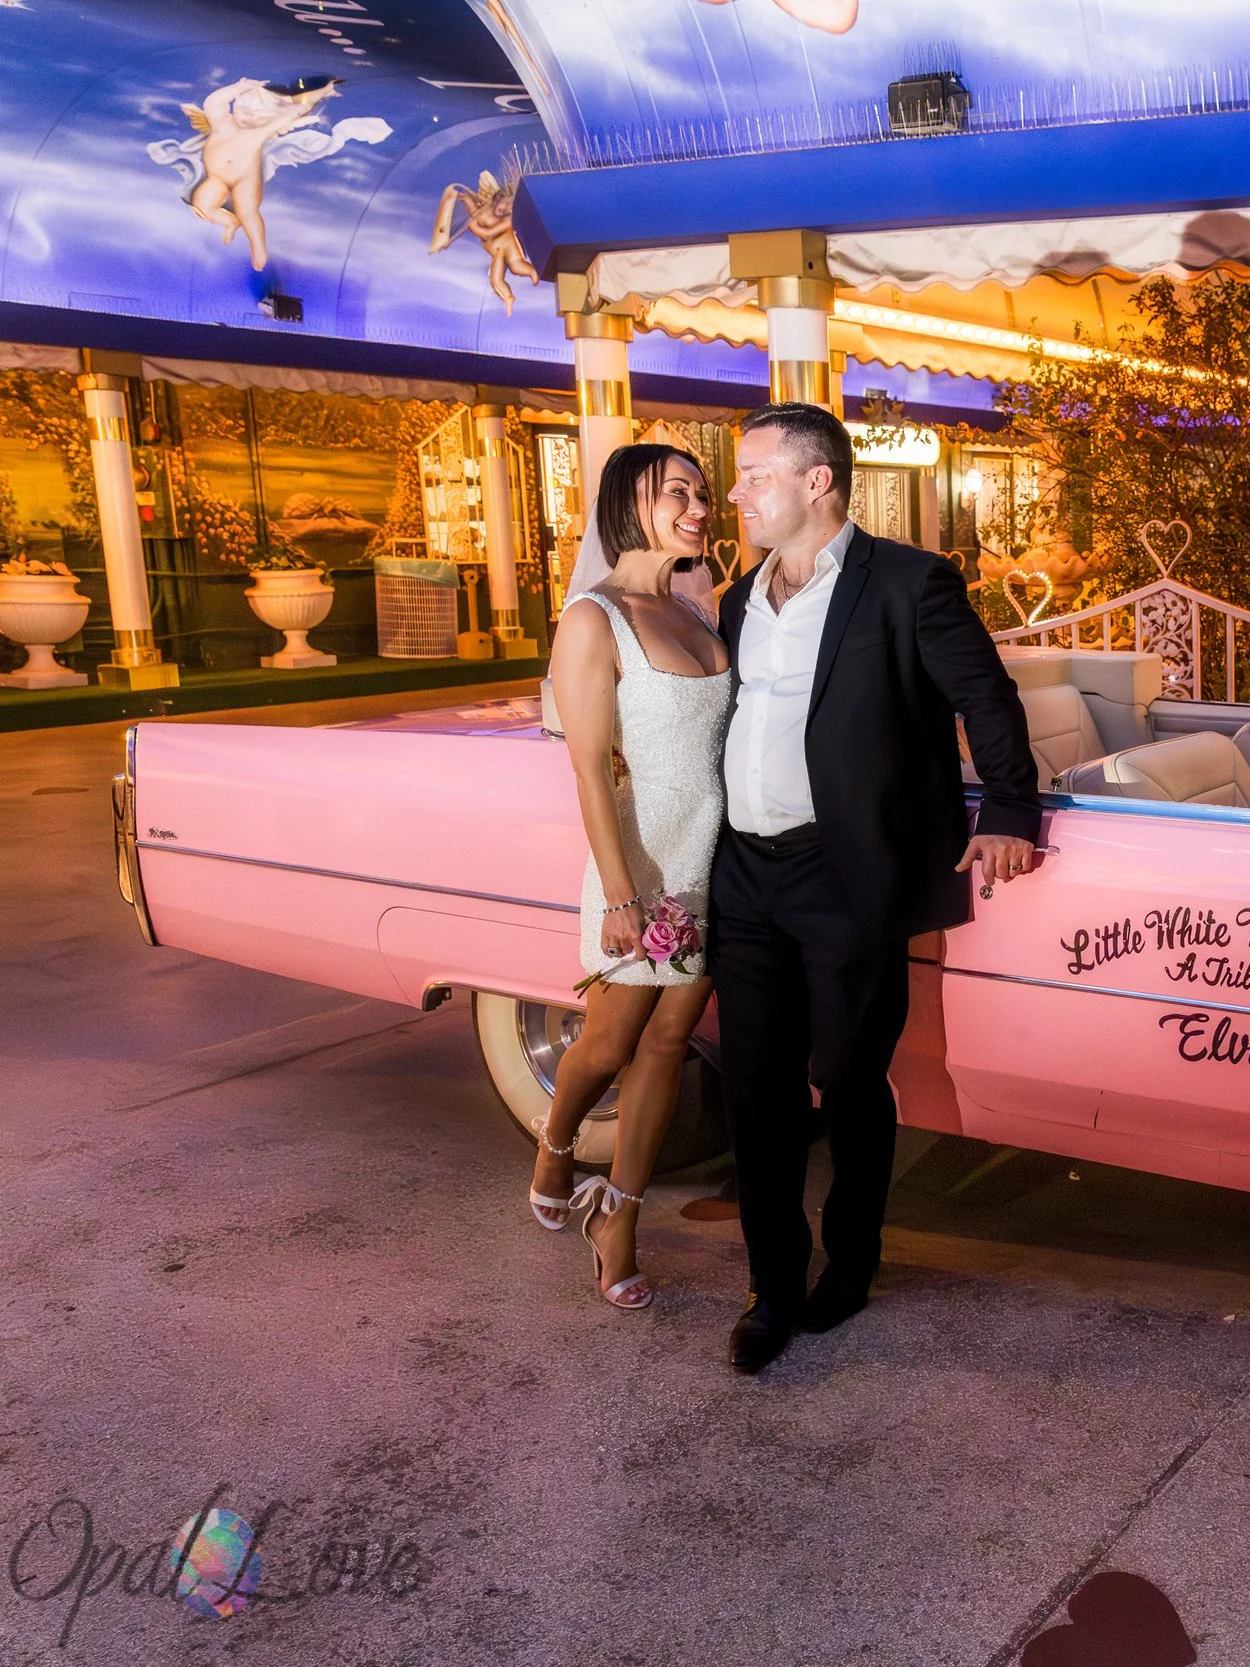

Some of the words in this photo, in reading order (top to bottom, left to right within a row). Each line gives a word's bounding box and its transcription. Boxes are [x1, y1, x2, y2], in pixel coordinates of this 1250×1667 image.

[1060, 917, 1146, 975] Little
[1144, 906, 1231, 950] White
[1165, 952, 1198, 983] A
